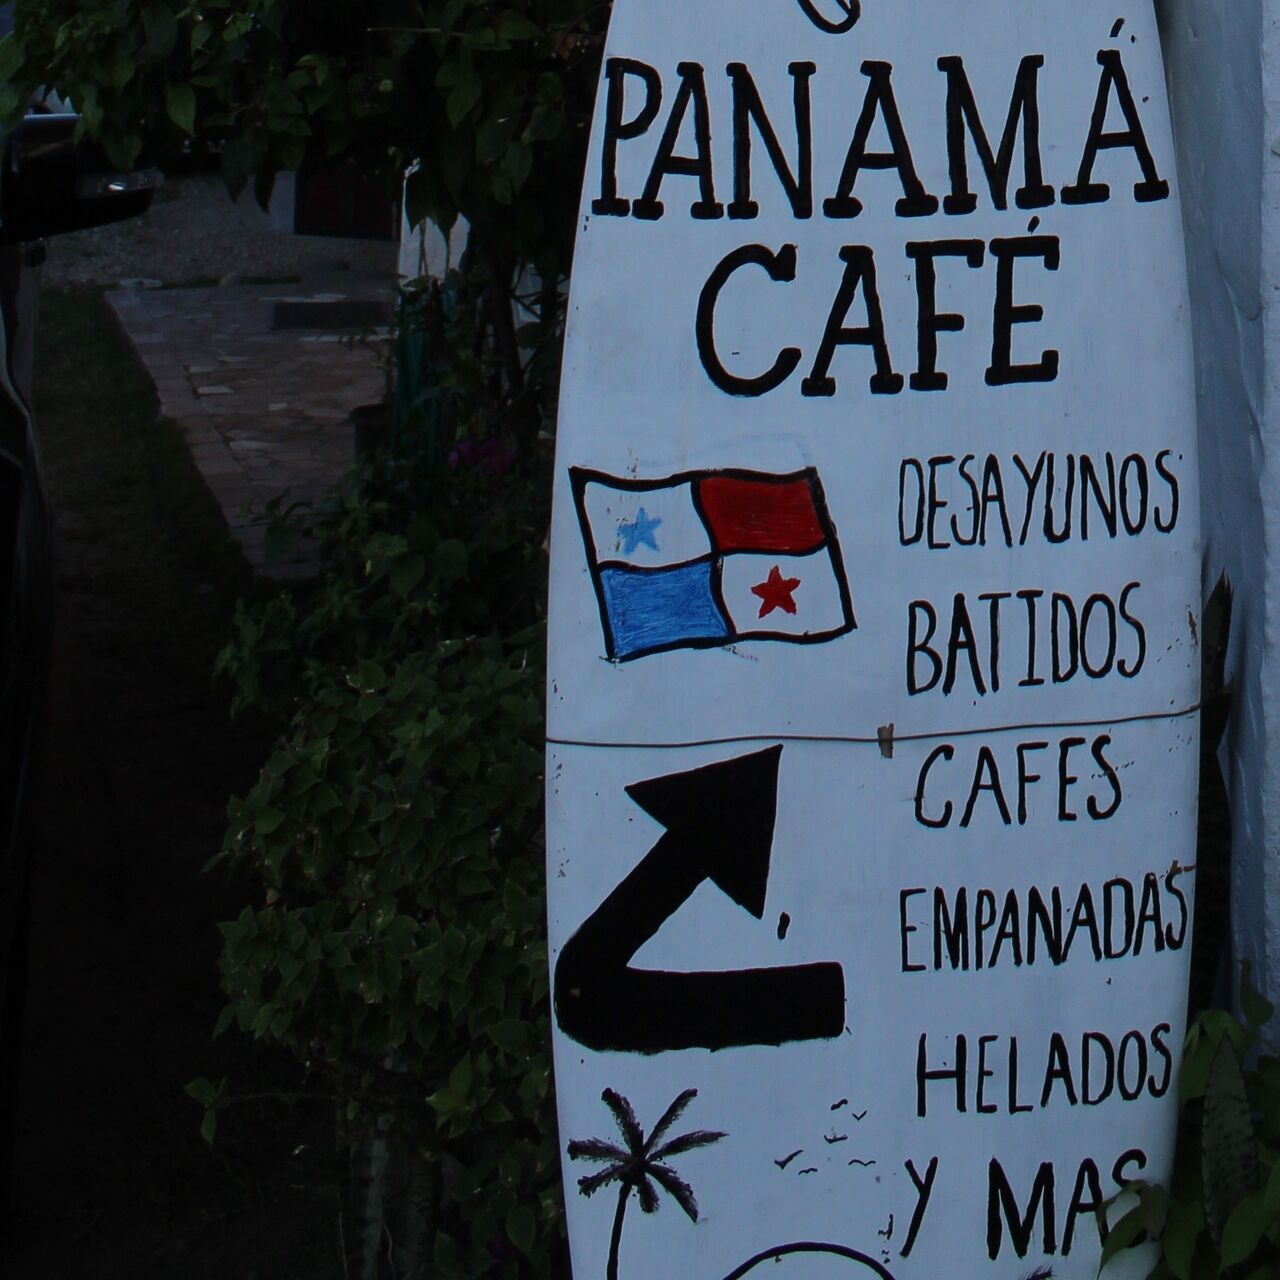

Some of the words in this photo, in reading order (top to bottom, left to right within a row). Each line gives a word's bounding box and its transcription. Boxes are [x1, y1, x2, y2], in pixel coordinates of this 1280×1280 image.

[591, 17, 1170, 220] PANAMÁ
[695, 216, 1060, 398] CAFÉ
[899, 450, 1179, 549] DESAYUNOS
[907, 582, 1147, 697] BATIDOS
[914, 734, 1122, 829] CAFES
[900, 868, 1188, 973] EMPANADAS
[917, 1022, 1173, 1117] HELADOS
[900, 1156, 939, 1258] Y
